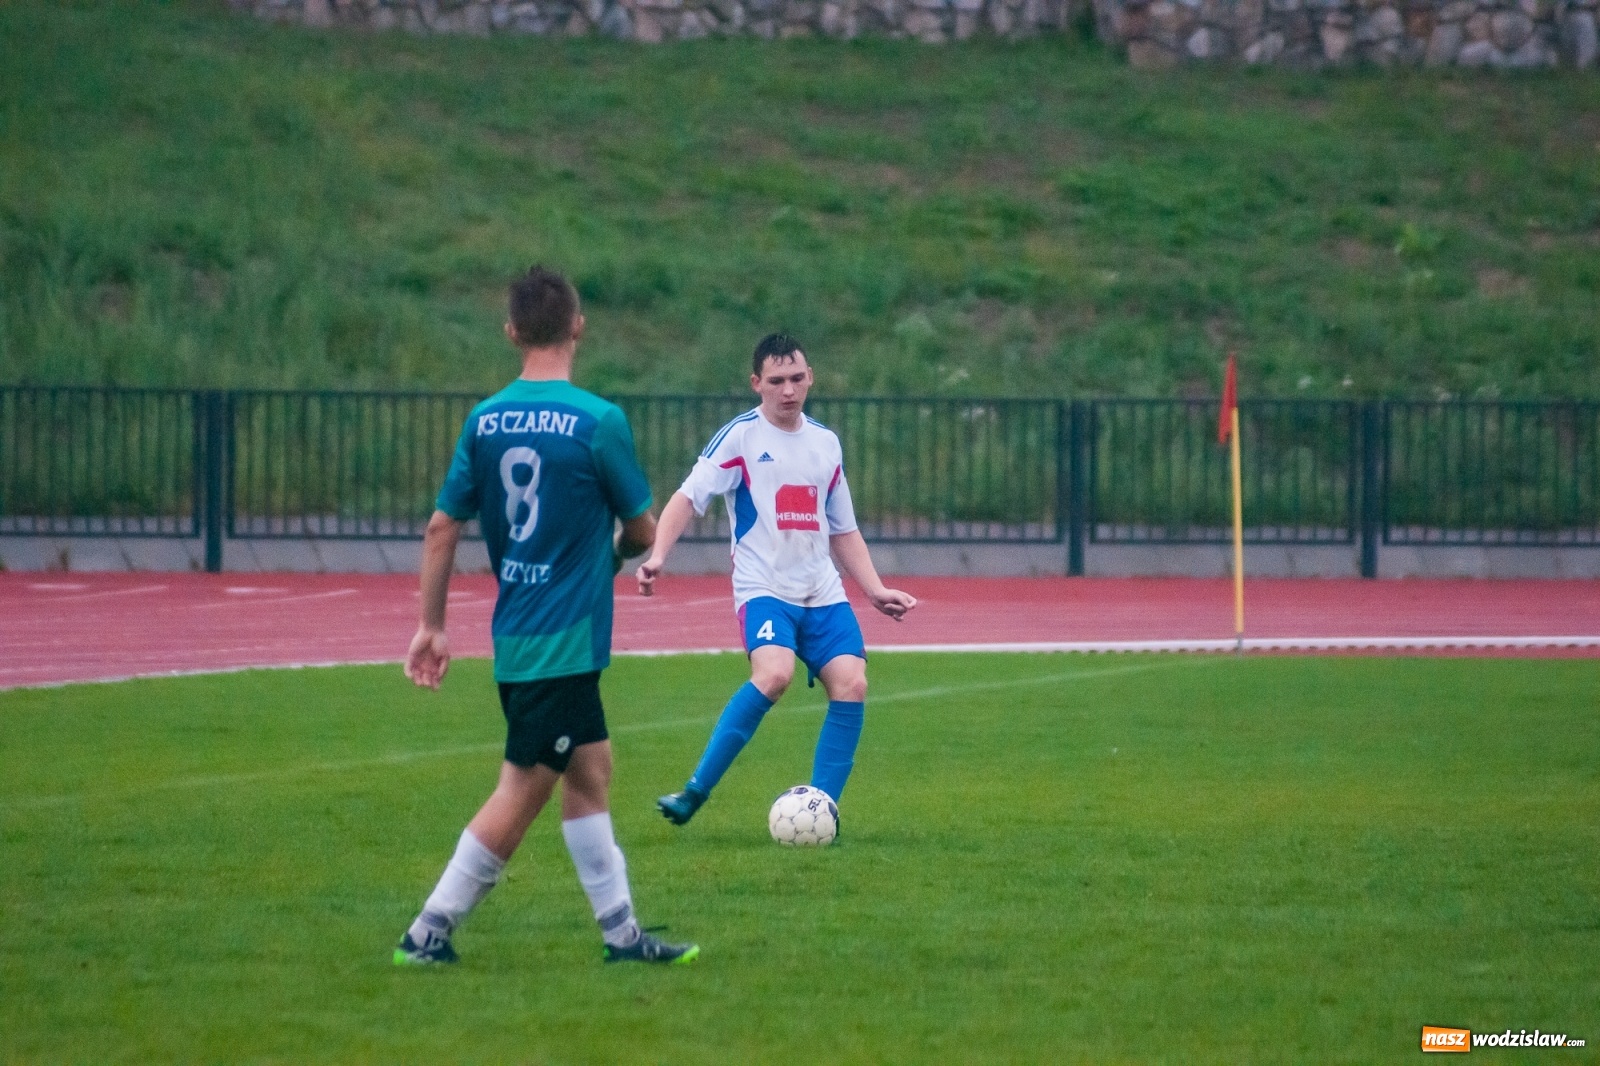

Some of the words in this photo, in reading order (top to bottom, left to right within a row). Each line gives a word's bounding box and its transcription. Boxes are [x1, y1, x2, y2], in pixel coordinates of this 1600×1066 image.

[477, 412, 499, 436] KS
[501, 410, 579, 437] CZARNI
[500, 446, 541, 542] 8
[756, 620, 775, 640] 4
